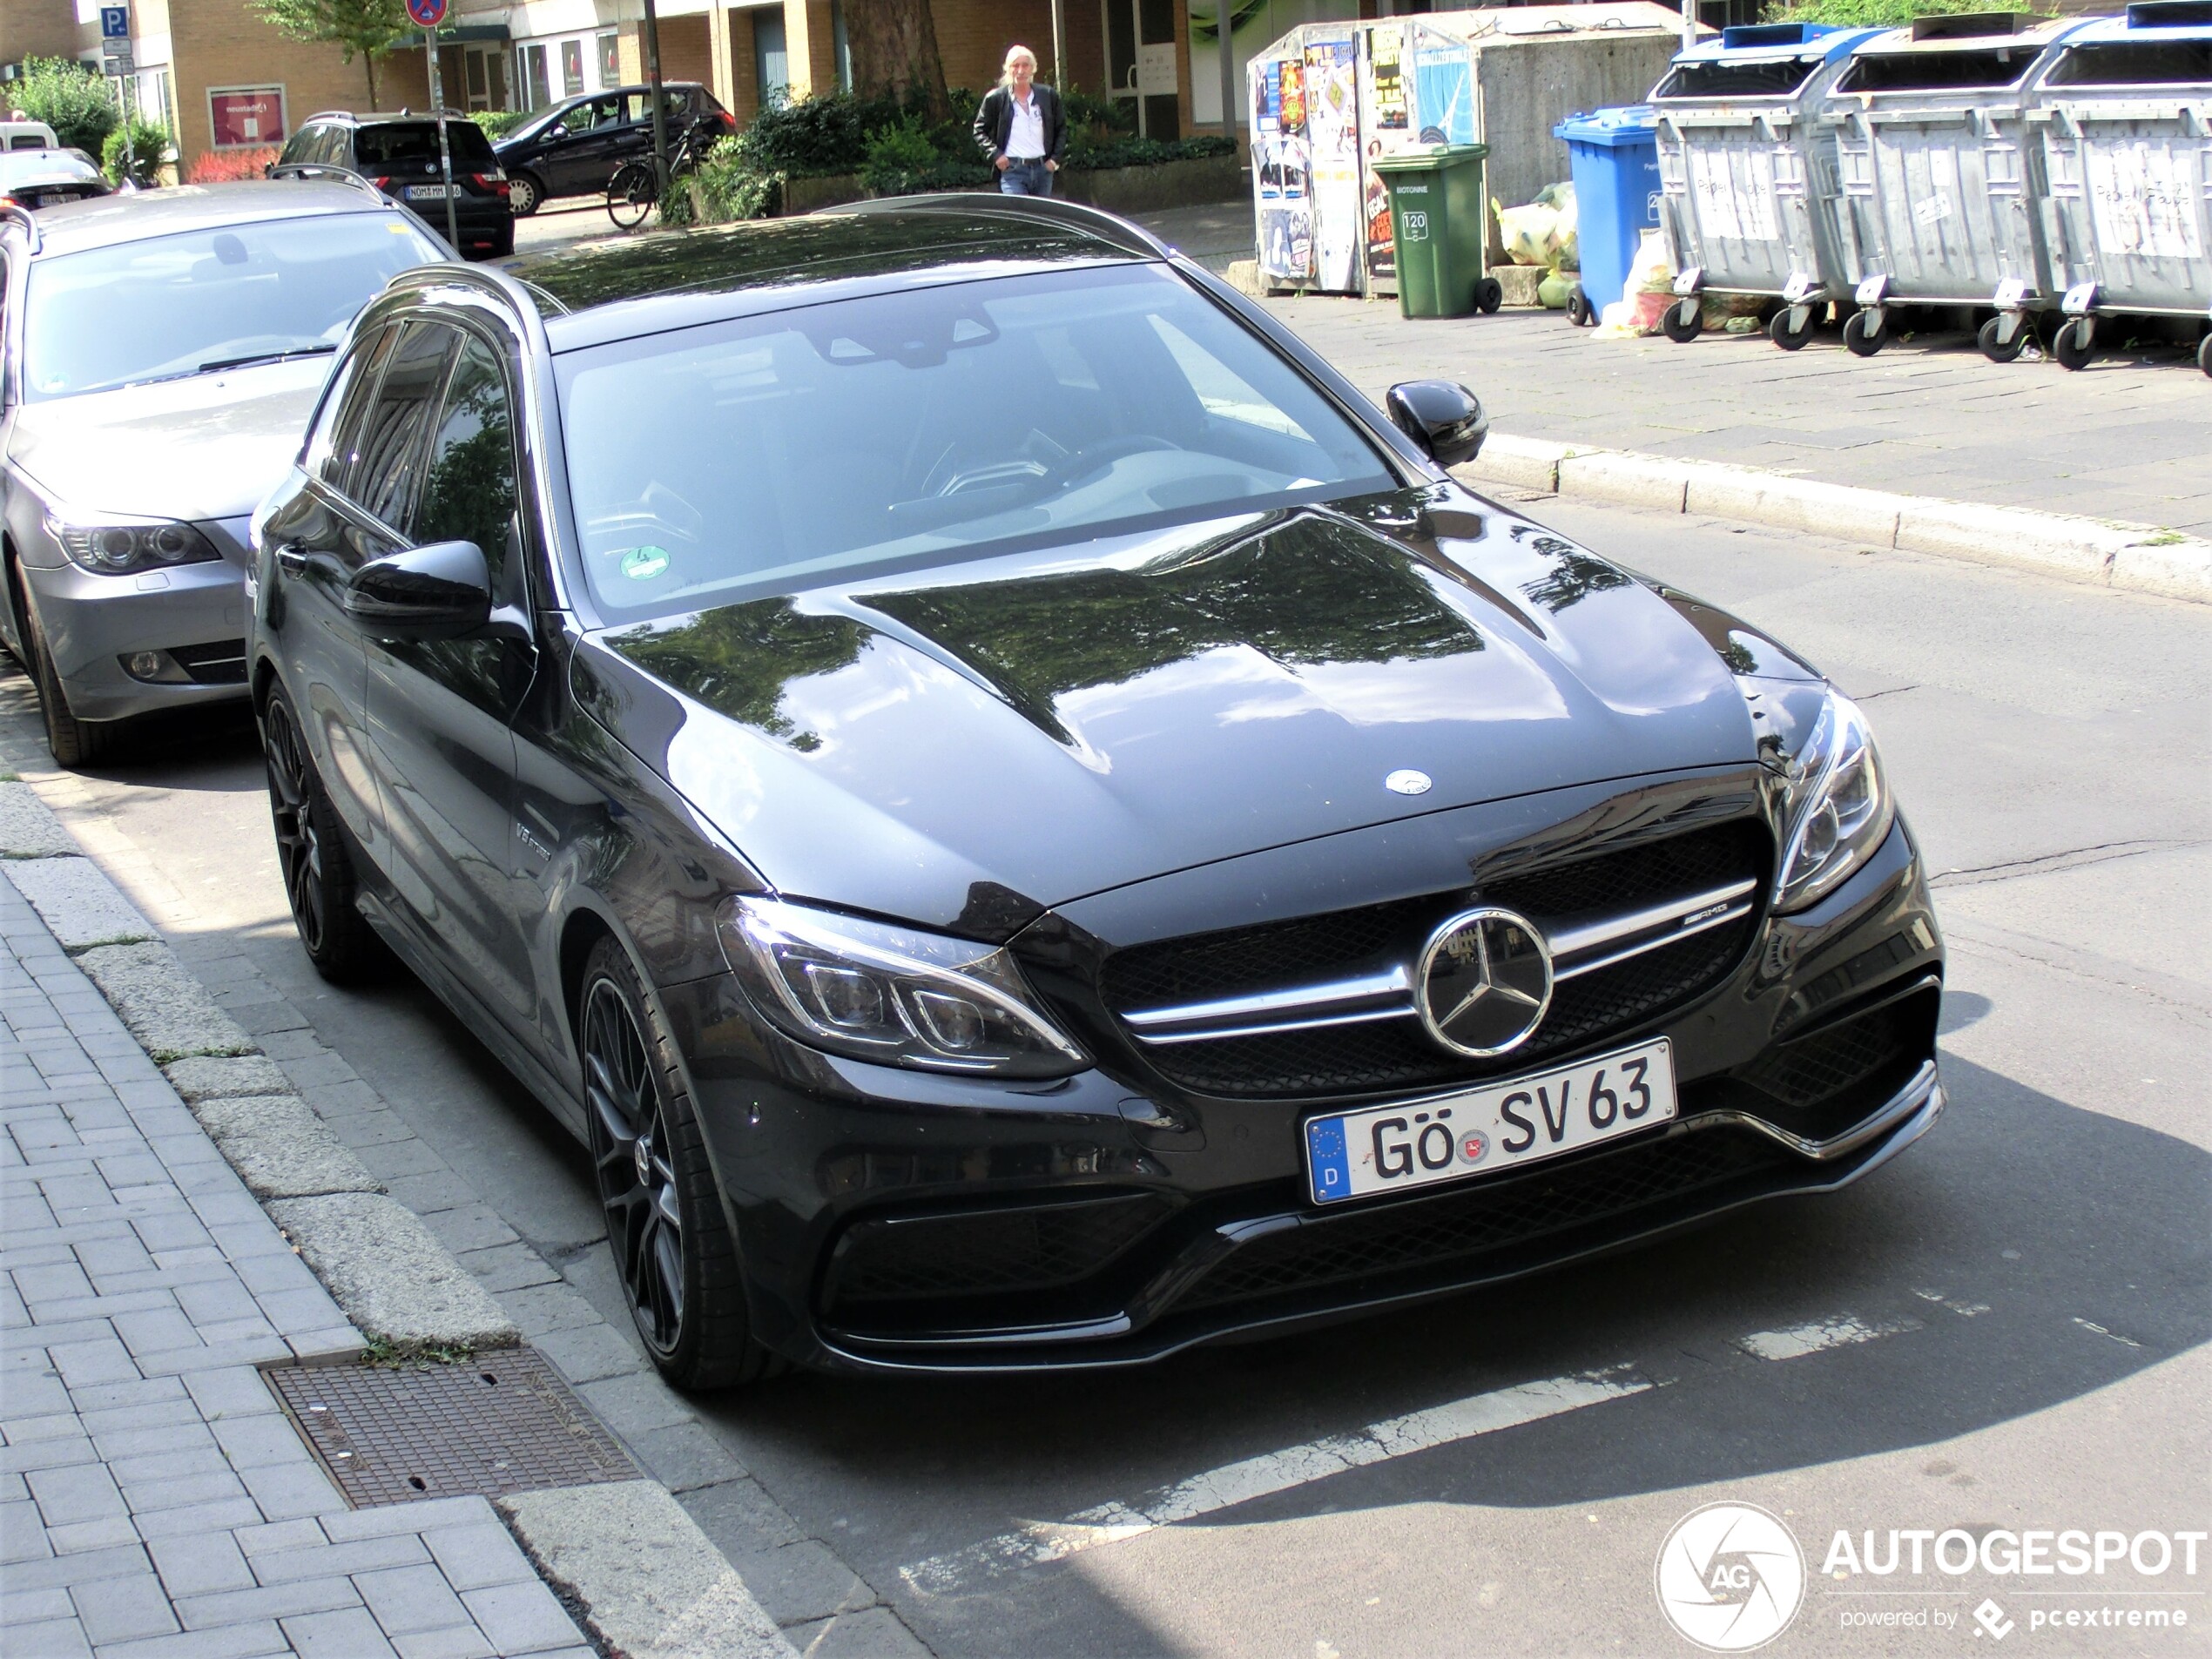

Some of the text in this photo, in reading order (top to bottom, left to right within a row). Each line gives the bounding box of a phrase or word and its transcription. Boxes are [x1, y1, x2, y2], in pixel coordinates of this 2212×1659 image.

[107, 10, 121, 34] P
[411, 186, 427, 197] NOM
[1397, 185, 1428, 194] BIOTONNE
[1404, 214, 1425, 228] 120
[1697, 903, 1728, 920] AMG
[1371, 1108, 1455, 1179] GÖ
[1500, 1079, 1570, 1154] SV
[1588, 1056, 1652, 1130] 63
[1325, 1168, 1339, 1186] D
